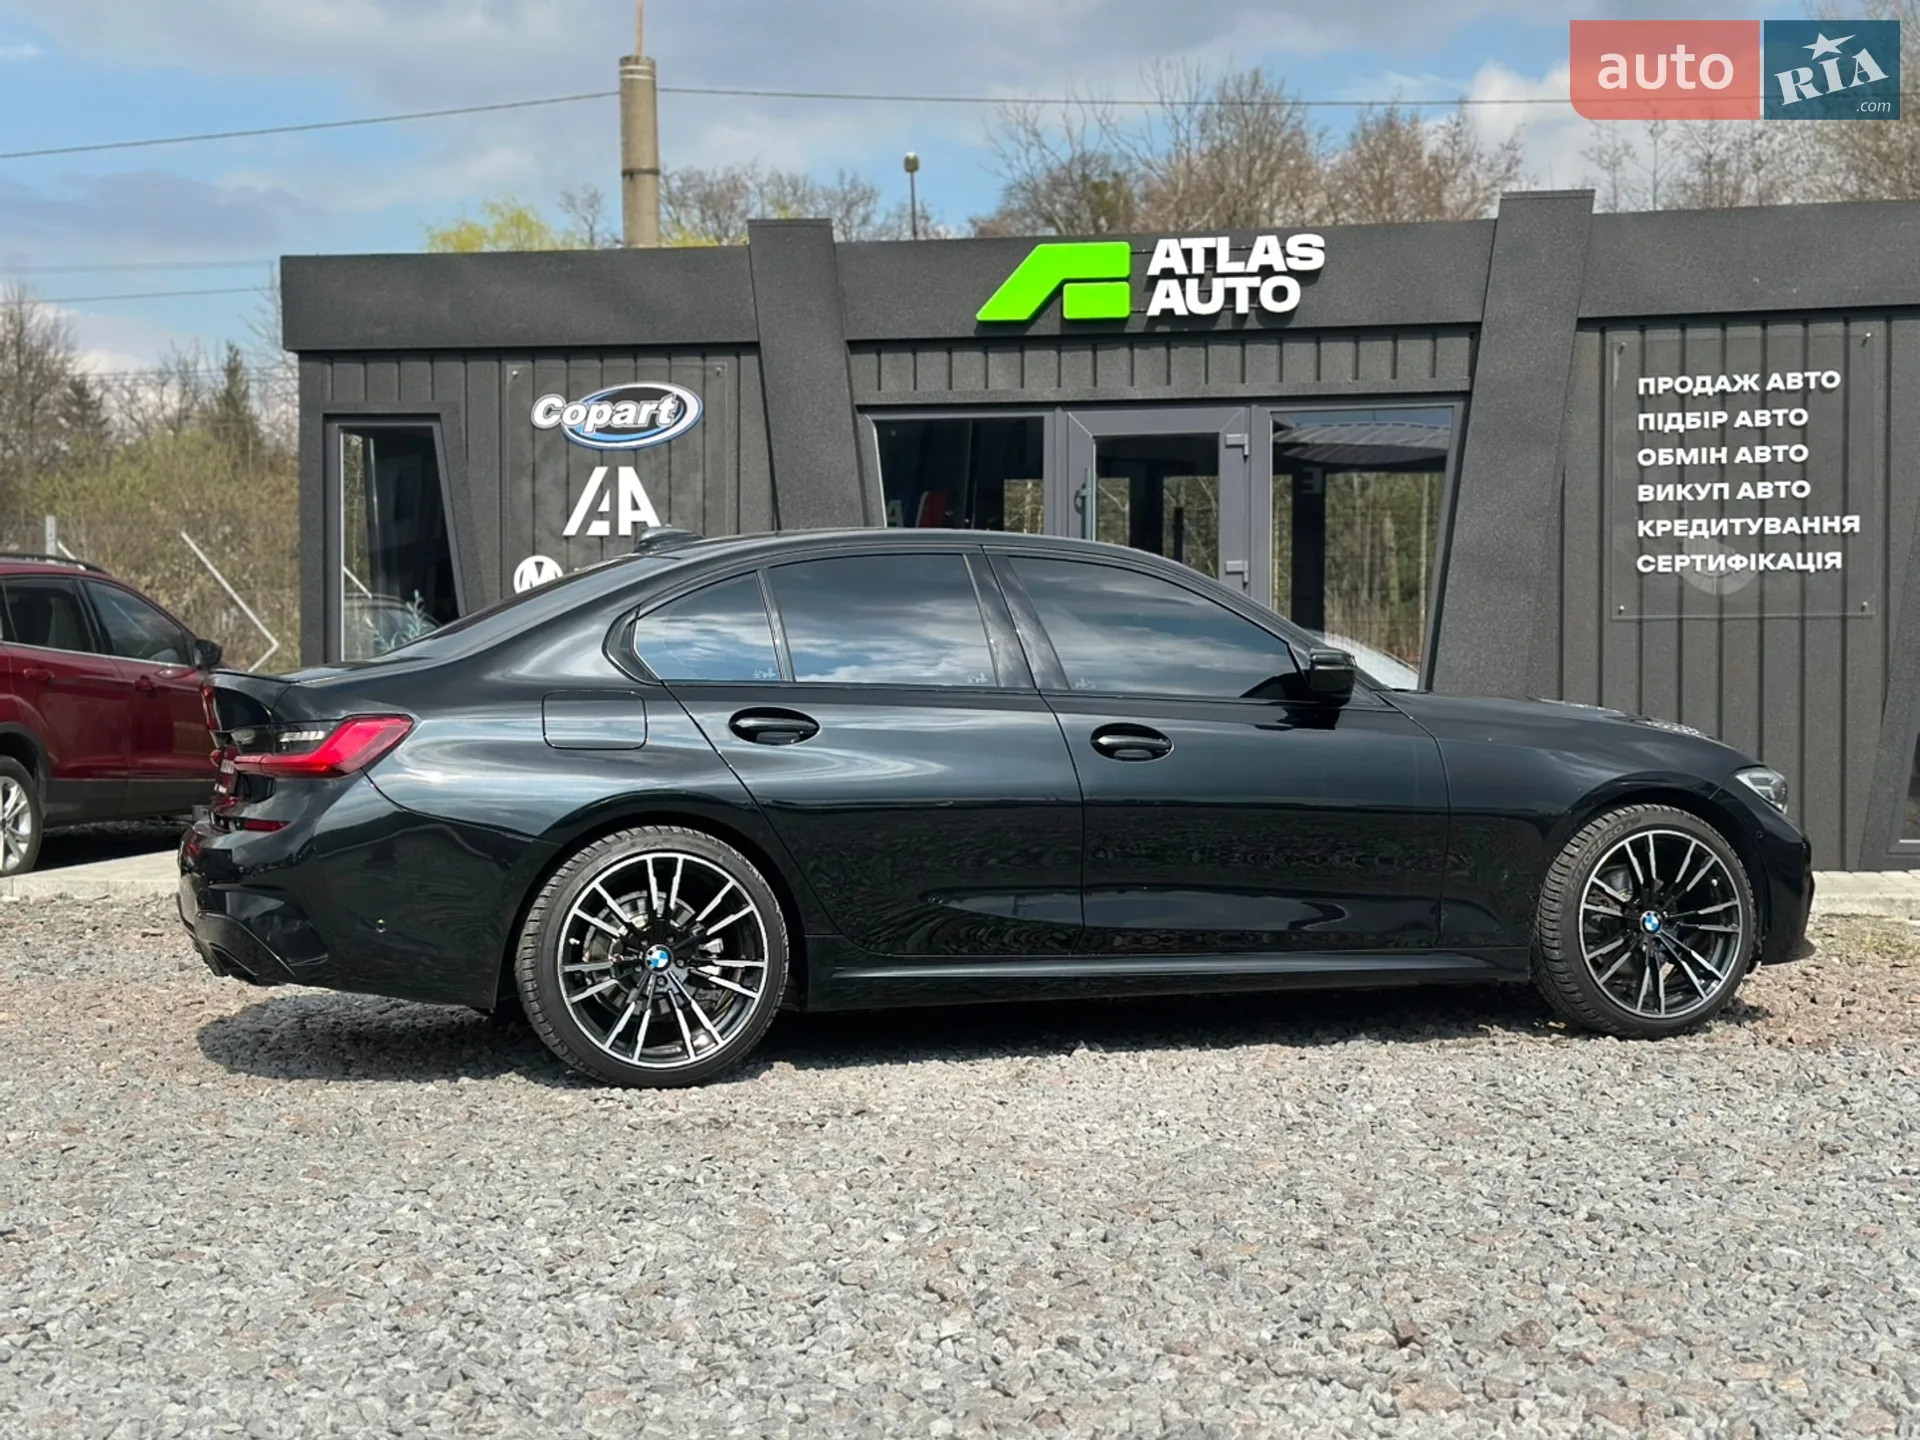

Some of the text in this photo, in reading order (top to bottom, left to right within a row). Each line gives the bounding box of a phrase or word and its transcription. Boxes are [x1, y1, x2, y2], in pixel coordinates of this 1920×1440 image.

[1147, 234, 1325, 275] ATLAS
[1147, 276, 1301, 316] AUTO
[1638, 370, 1841, 396] ПРОДАЖ АВТО
[531, 394, 678, 433] Copart
[1638, 408, 1809, 433] ПІДБІР АВТО
[1637, 444, 1809, 466] ОБМІН АВТО
[1638, 480, 1811, 502] ВИКУП АВТО
[1638, 515, 1860, 539] КРЕДИТУВАННЯ
[1636, 552, 1842, 573] СЕРТИФІКАЦІЯ
